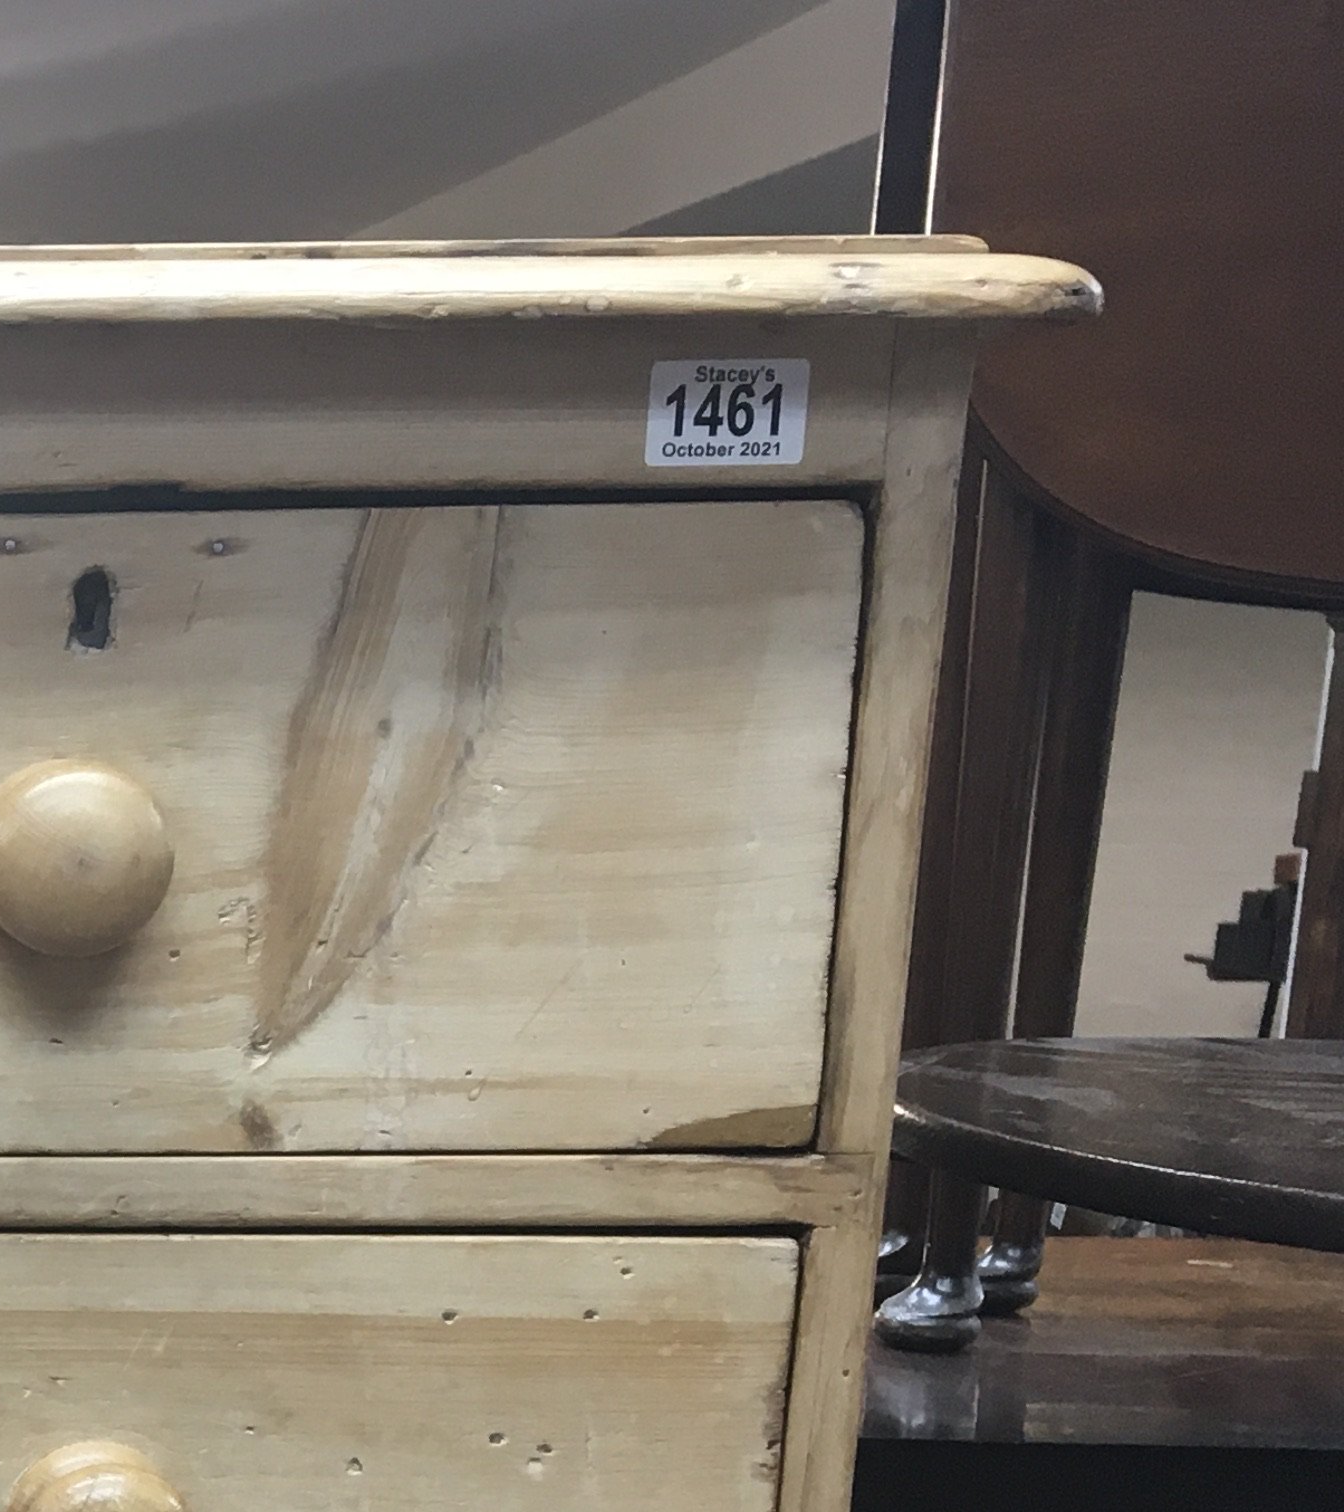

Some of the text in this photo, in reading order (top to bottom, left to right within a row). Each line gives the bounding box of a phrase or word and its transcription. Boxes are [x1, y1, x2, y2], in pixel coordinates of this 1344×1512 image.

[695, 365, 775, 384] Stacey's
[666, 383, 783, 437] 1461
[662, 441, 781, 457] October 2021
